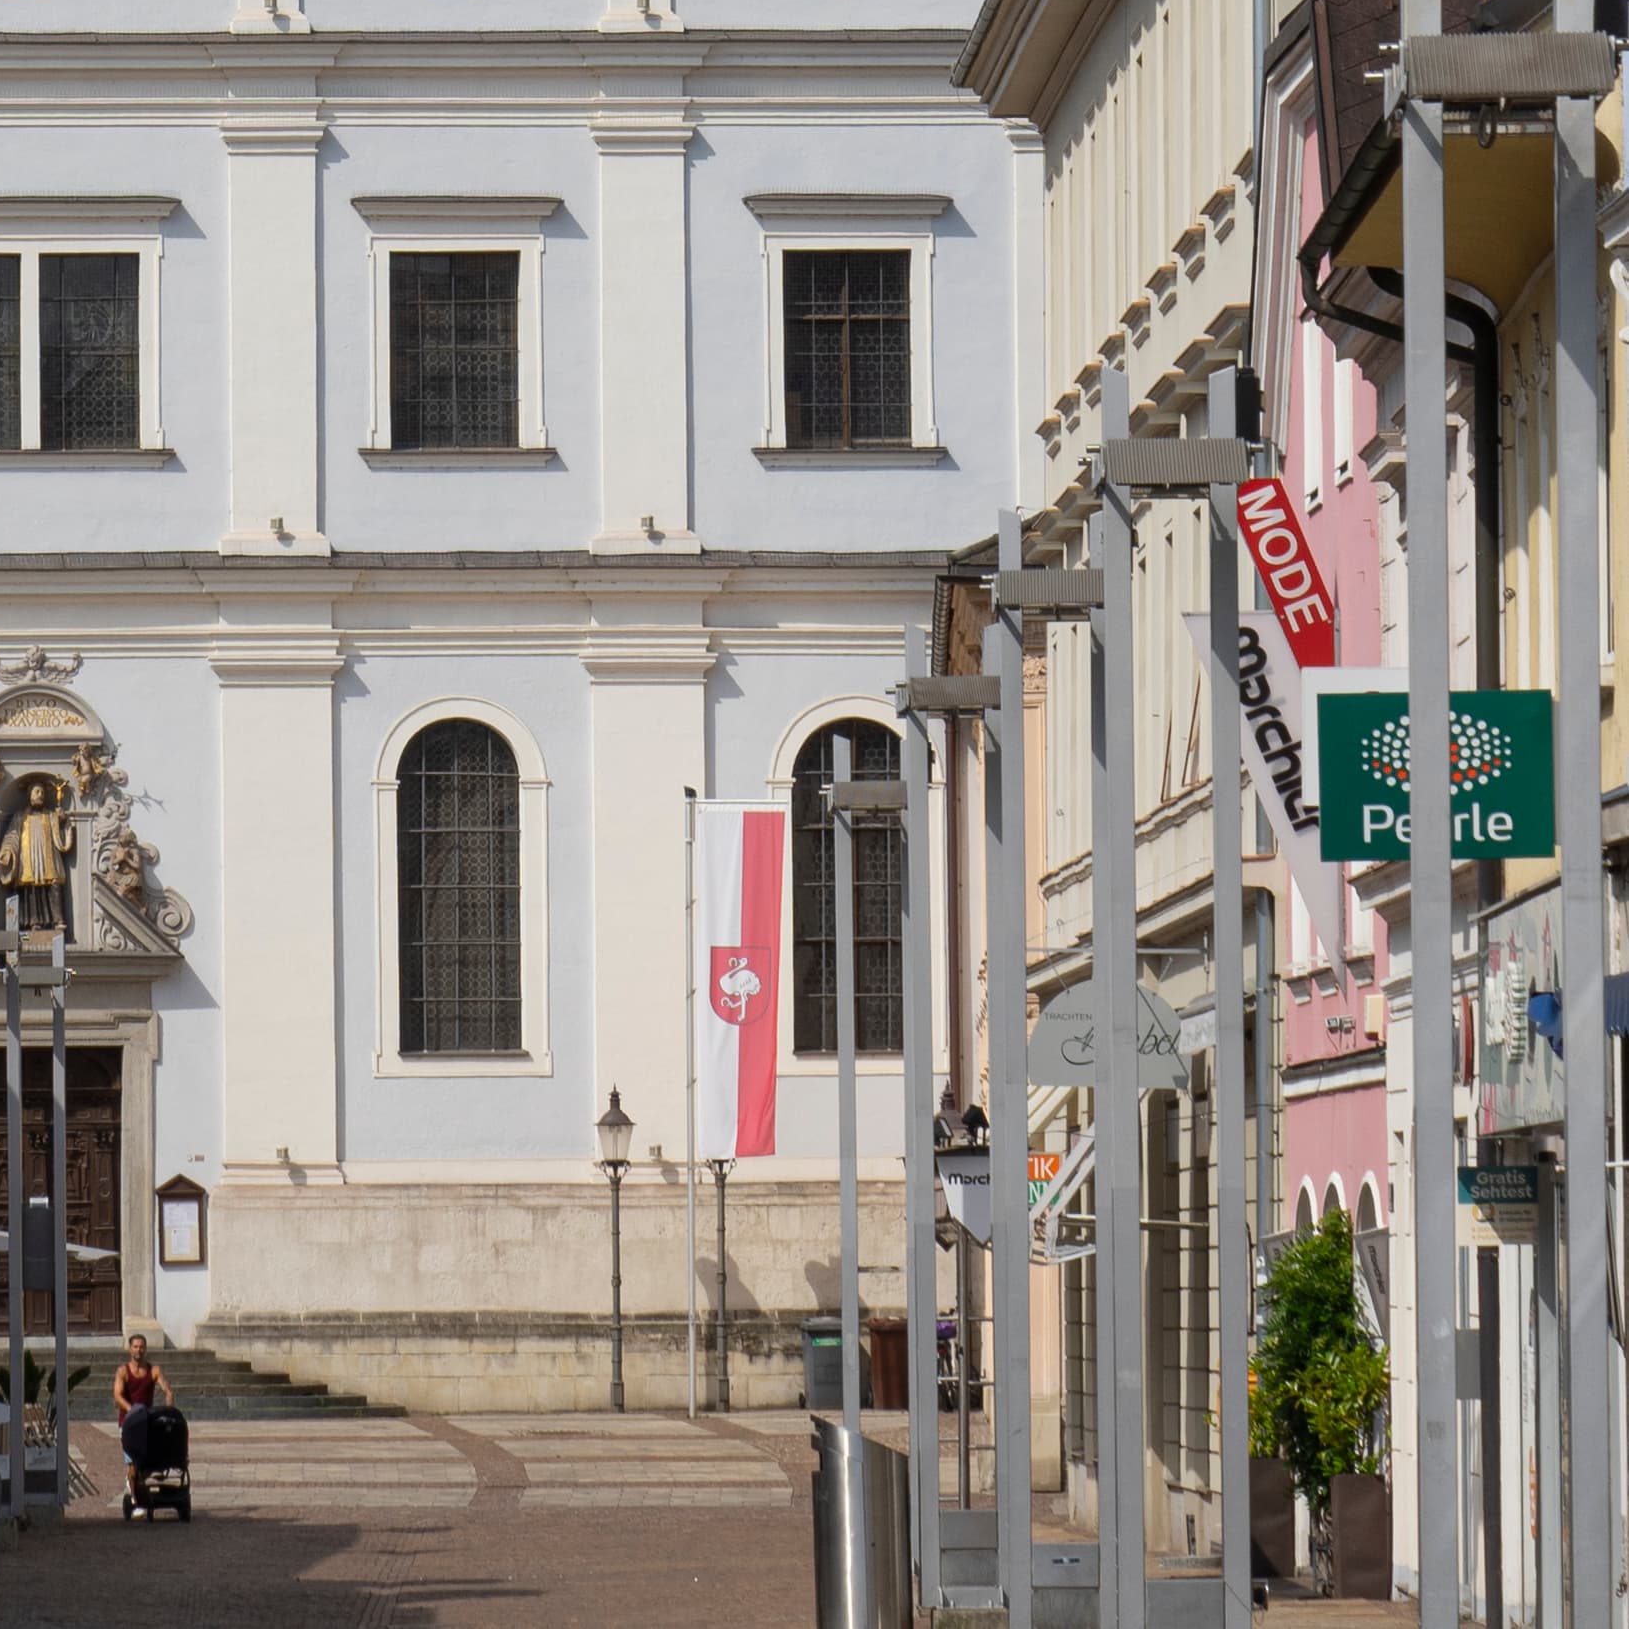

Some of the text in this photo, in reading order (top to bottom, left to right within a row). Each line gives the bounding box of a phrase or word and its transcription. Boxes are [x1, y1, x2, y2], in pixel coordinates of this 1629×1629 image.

[1238, 484, 1329, 634] MODE
[16, 699, 57, 708] DIVO
[1362, 802, 1514, 843] Perle
[1044, 1013, 1092, 1021] TRACHTEN
[1476, 1169, 1526, 1183] Gratis
[1471, 1184, 1533, 1198] Sehtest
